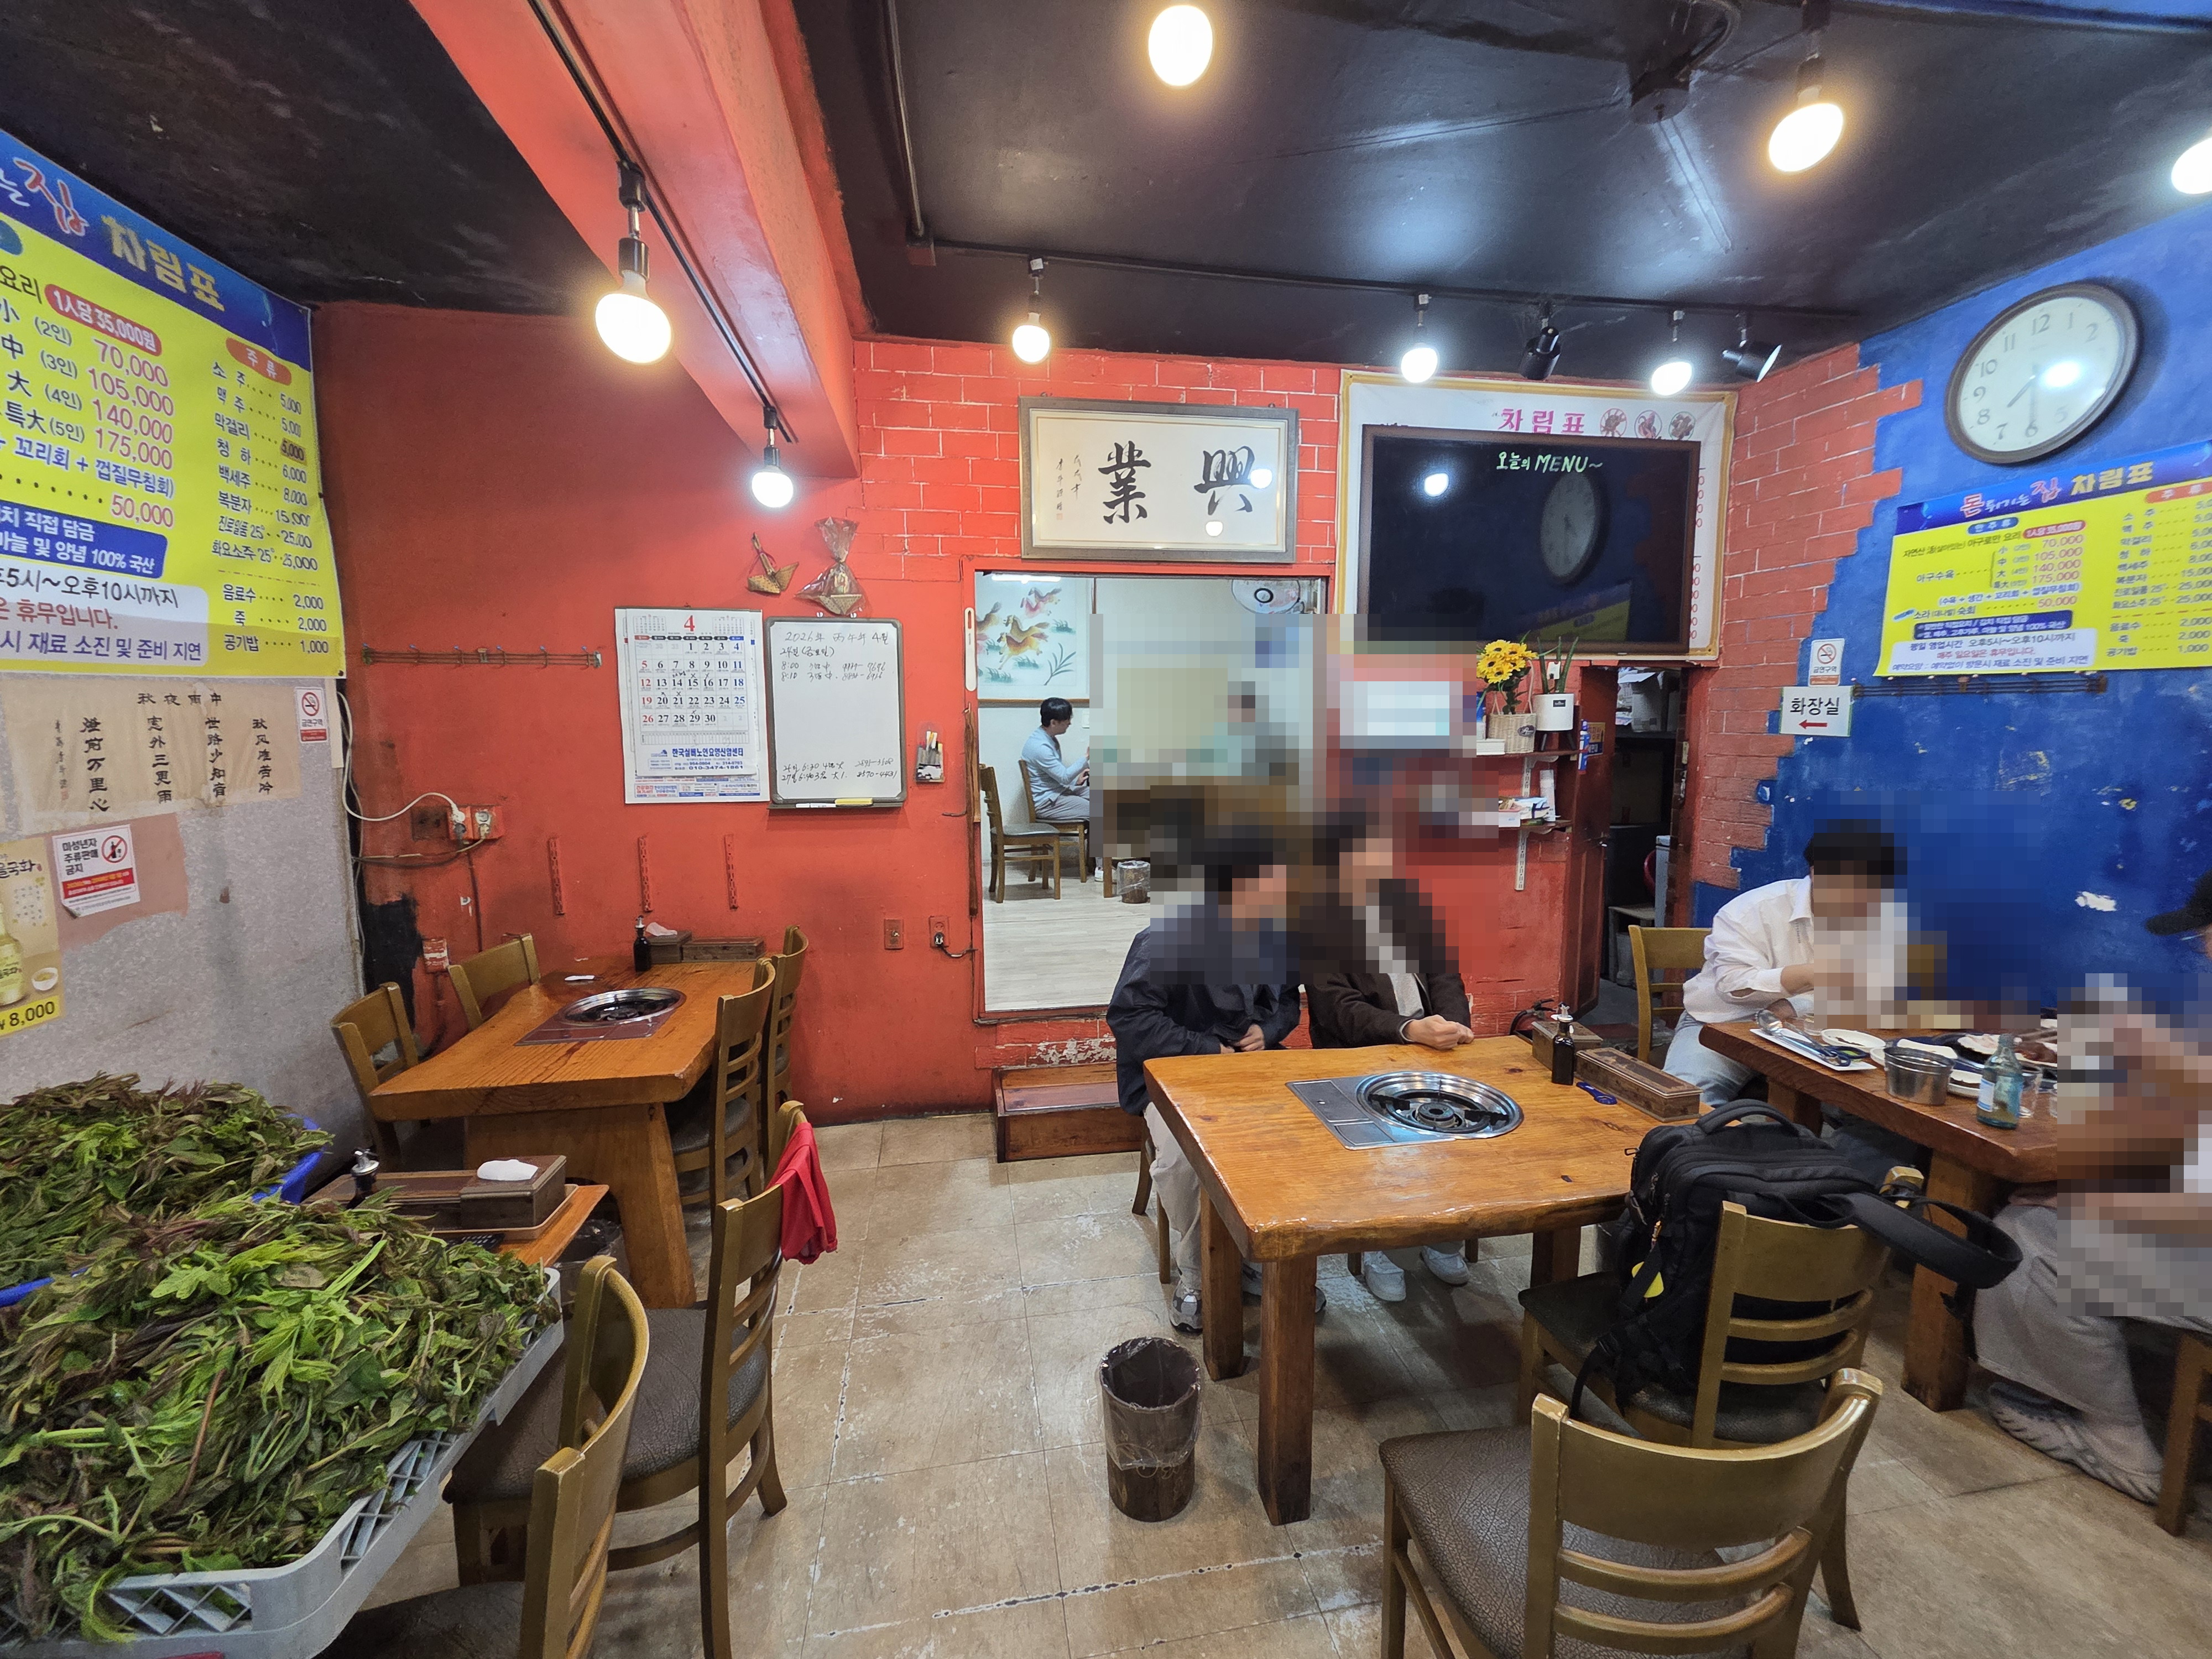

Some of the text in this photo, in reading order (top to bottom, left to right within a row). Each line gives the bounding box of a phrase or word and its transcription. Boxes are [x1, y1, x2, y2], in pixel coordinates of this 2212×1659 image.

[101, 214, 225, 311] 차림표
[2032, 314, 2051, 335] 12
[2068, 312, 2074, 330] 1
[2084, 322, 2099, 343] 2
[34, 316, 72, 347] (2인)
[93, 338, 168, 387] 70,000
[2003, 333, 2016, 353] 11
[1, 334, 174, 416] 中 (3인) 105,000
[1980, 359, 1997, 378] 10
[1973, 386, 1986, 403] 9
[7, 370, 173, 444] 大 (4인) 140,000
[1498, 409, 1585, 434] 차림표
[1977, 409, 1991, 425] 8
[215, 413, 305, 461] 막걸리 5,000
[1995, 422, 2008, 440] 7
[2025, 418, 2039, 438] 6
[49, 416, 85, 444] (5인)
[96, 427, 173, 470] 175,000
[14, 436, 175, 499] 꼬리회 껍질무침회)
[1496, 451, 1531, 470] 오늘의
[283, 464, 307, 484] 6,000
[2070, 461, 2153, 495] 차림표
[218, 465, 308, 507] 백세주 8,000
[111, 494, 174, 528] 50,000
[218, 491, 252, 515] 복분자
[24, 512, 59, 535] 직접
[62, 519, 95, 542] 담금
[33, 536, 51, 557] 및
[55, 541, 87, 564] 양념
[91, 549, 127, 569] 100%
[129, 555, 155, 574] 국산
[211, 540, 256, 561] 화요소주
[282, 553, 318, 571] 25,000
[1916, 570, 1954, 582] 아구수육
[0, 567, 179, 608] 5시~오후10시까지
[223, 583, 324, 610] 음료수 2,000
[17, 599, 118, 629] 휴무입니다.
[234, 611, 327, 632] 죽 2,000
[684, 615, 695, 632] 4
[28, 632, 67, 654] 재료
[73, 636, 110, 656] 소진
[116, 638, 132, 658] 및
[137, 639, 167, 659] 준비
[173, 641, 201, 661] 지연
[225, 634, 328, 653] 공기밥 1,000
[641, 660, 648, 669] 5
[658, 660, 664, 669] 6
[673, 660, 679, 669] 7
[689, 660, 695, 669] 8
[705, 660, 709, 669] 9
[718, 660, 728, 669] 10
[734, 660, 742, 669] 11
[641, 679, 651, 687] 12
[657, 679, 667, 687] 13
[672, 679, 682, 687] 14
[688, 679, 698, 687] 15
[703, 679, 713, 687] 16
[719, 679, 728, 687] 17
[734, 679, 744, 687] 18
[641, 696, 652, 705] 19
[657, 696, 668, 705] 20
[673, 696, 683, 705] 21
[688, 696, 699, 705] 22
[704, 696, 714, 705] 23
[719, 696, 729, 705] 24
[734, 696, 745, 705] 25
[1790, 697, 1839, 716] 화장실
[62, 838, 97, 852] 미성년자
[65, 863, 84, 875] 금지
